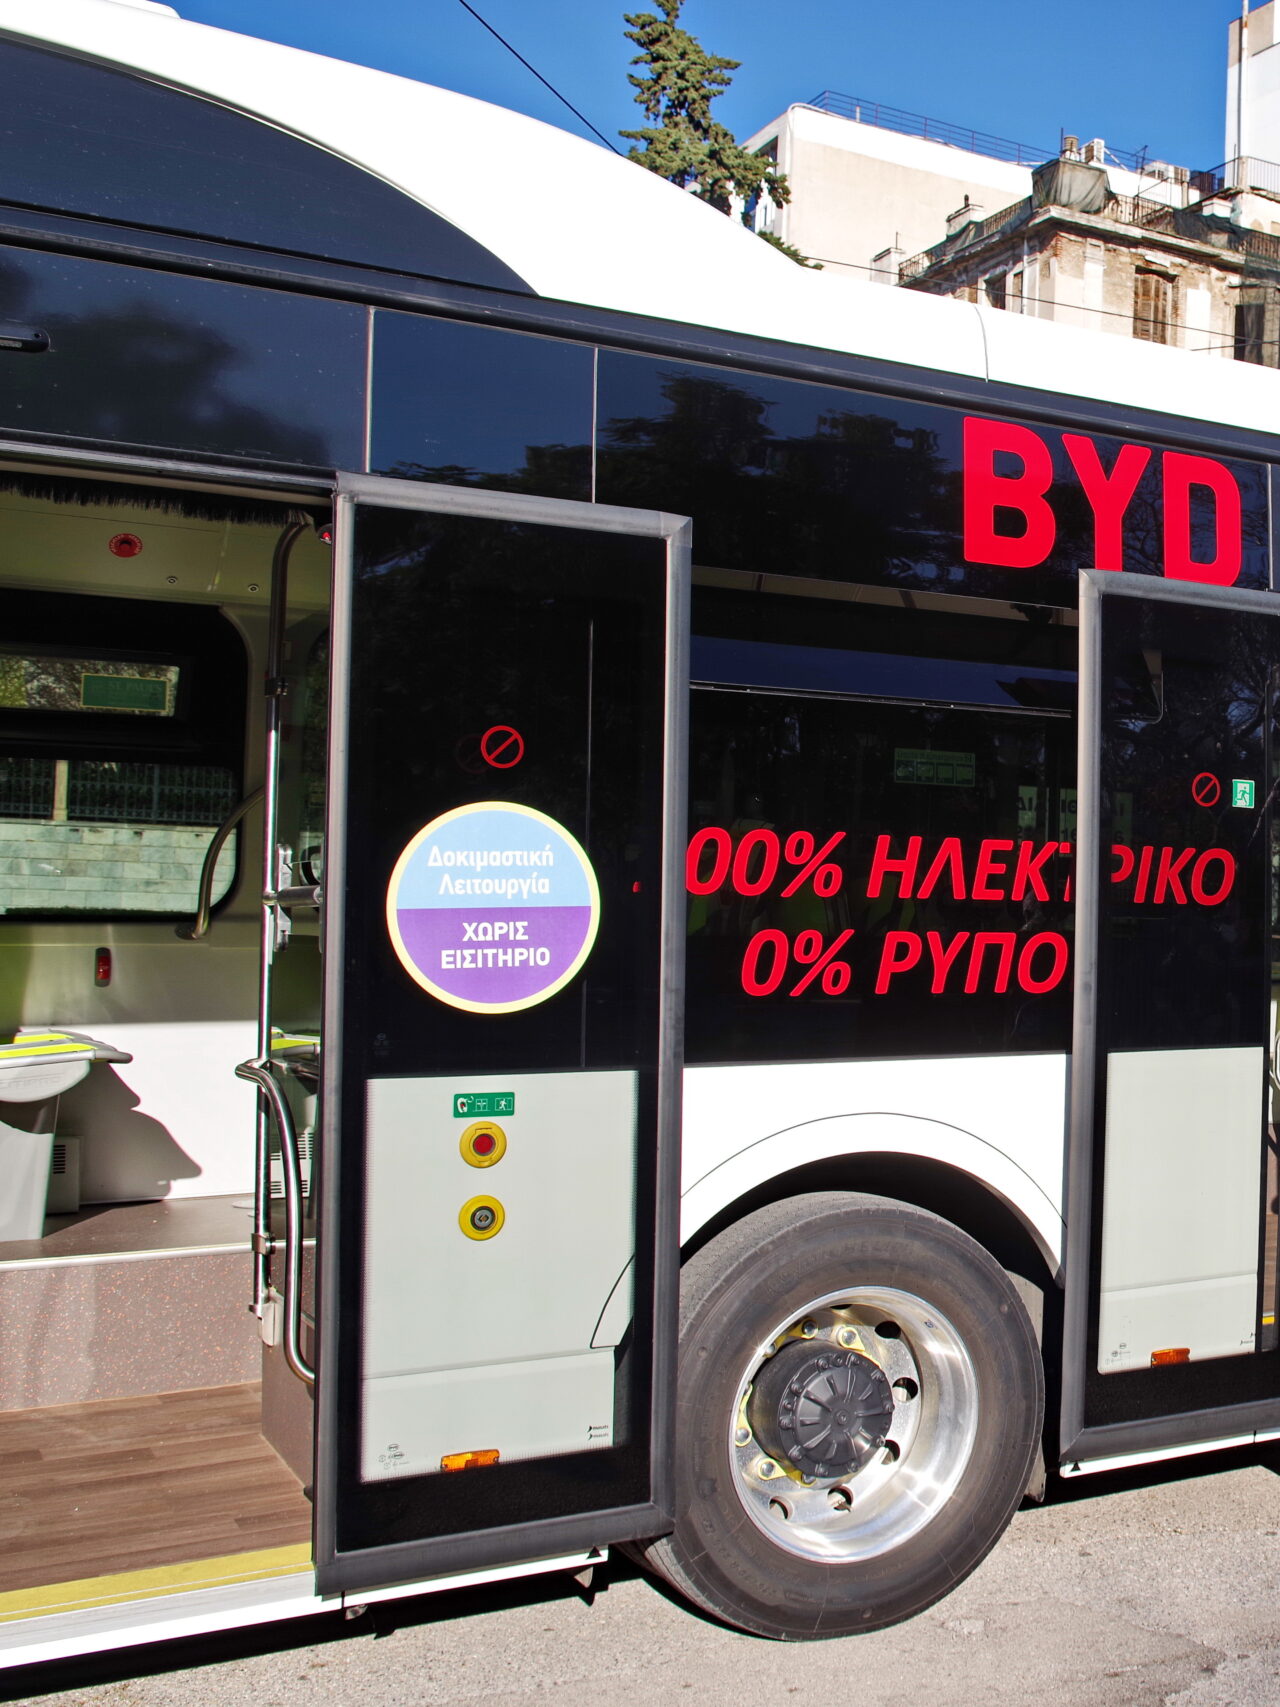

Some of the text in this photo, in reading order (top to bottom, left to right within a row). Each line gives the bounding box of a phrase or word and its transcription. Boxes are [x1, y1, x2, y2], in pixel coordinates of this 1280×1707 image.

[963, 416, 1242, 588] BYD
[427, 844, 554, 872] Δοκιμαστική
[633, 827, 846, 898] 00%
[439, 872, 550, 899] Λειτουργία
[462, 921, 529, 942] ΧΩΡΙΣ
[440, 947, 551, 970] ΕΙΣΙΤΗΡΙΟ
[742, 929, 854, 996] 0%
